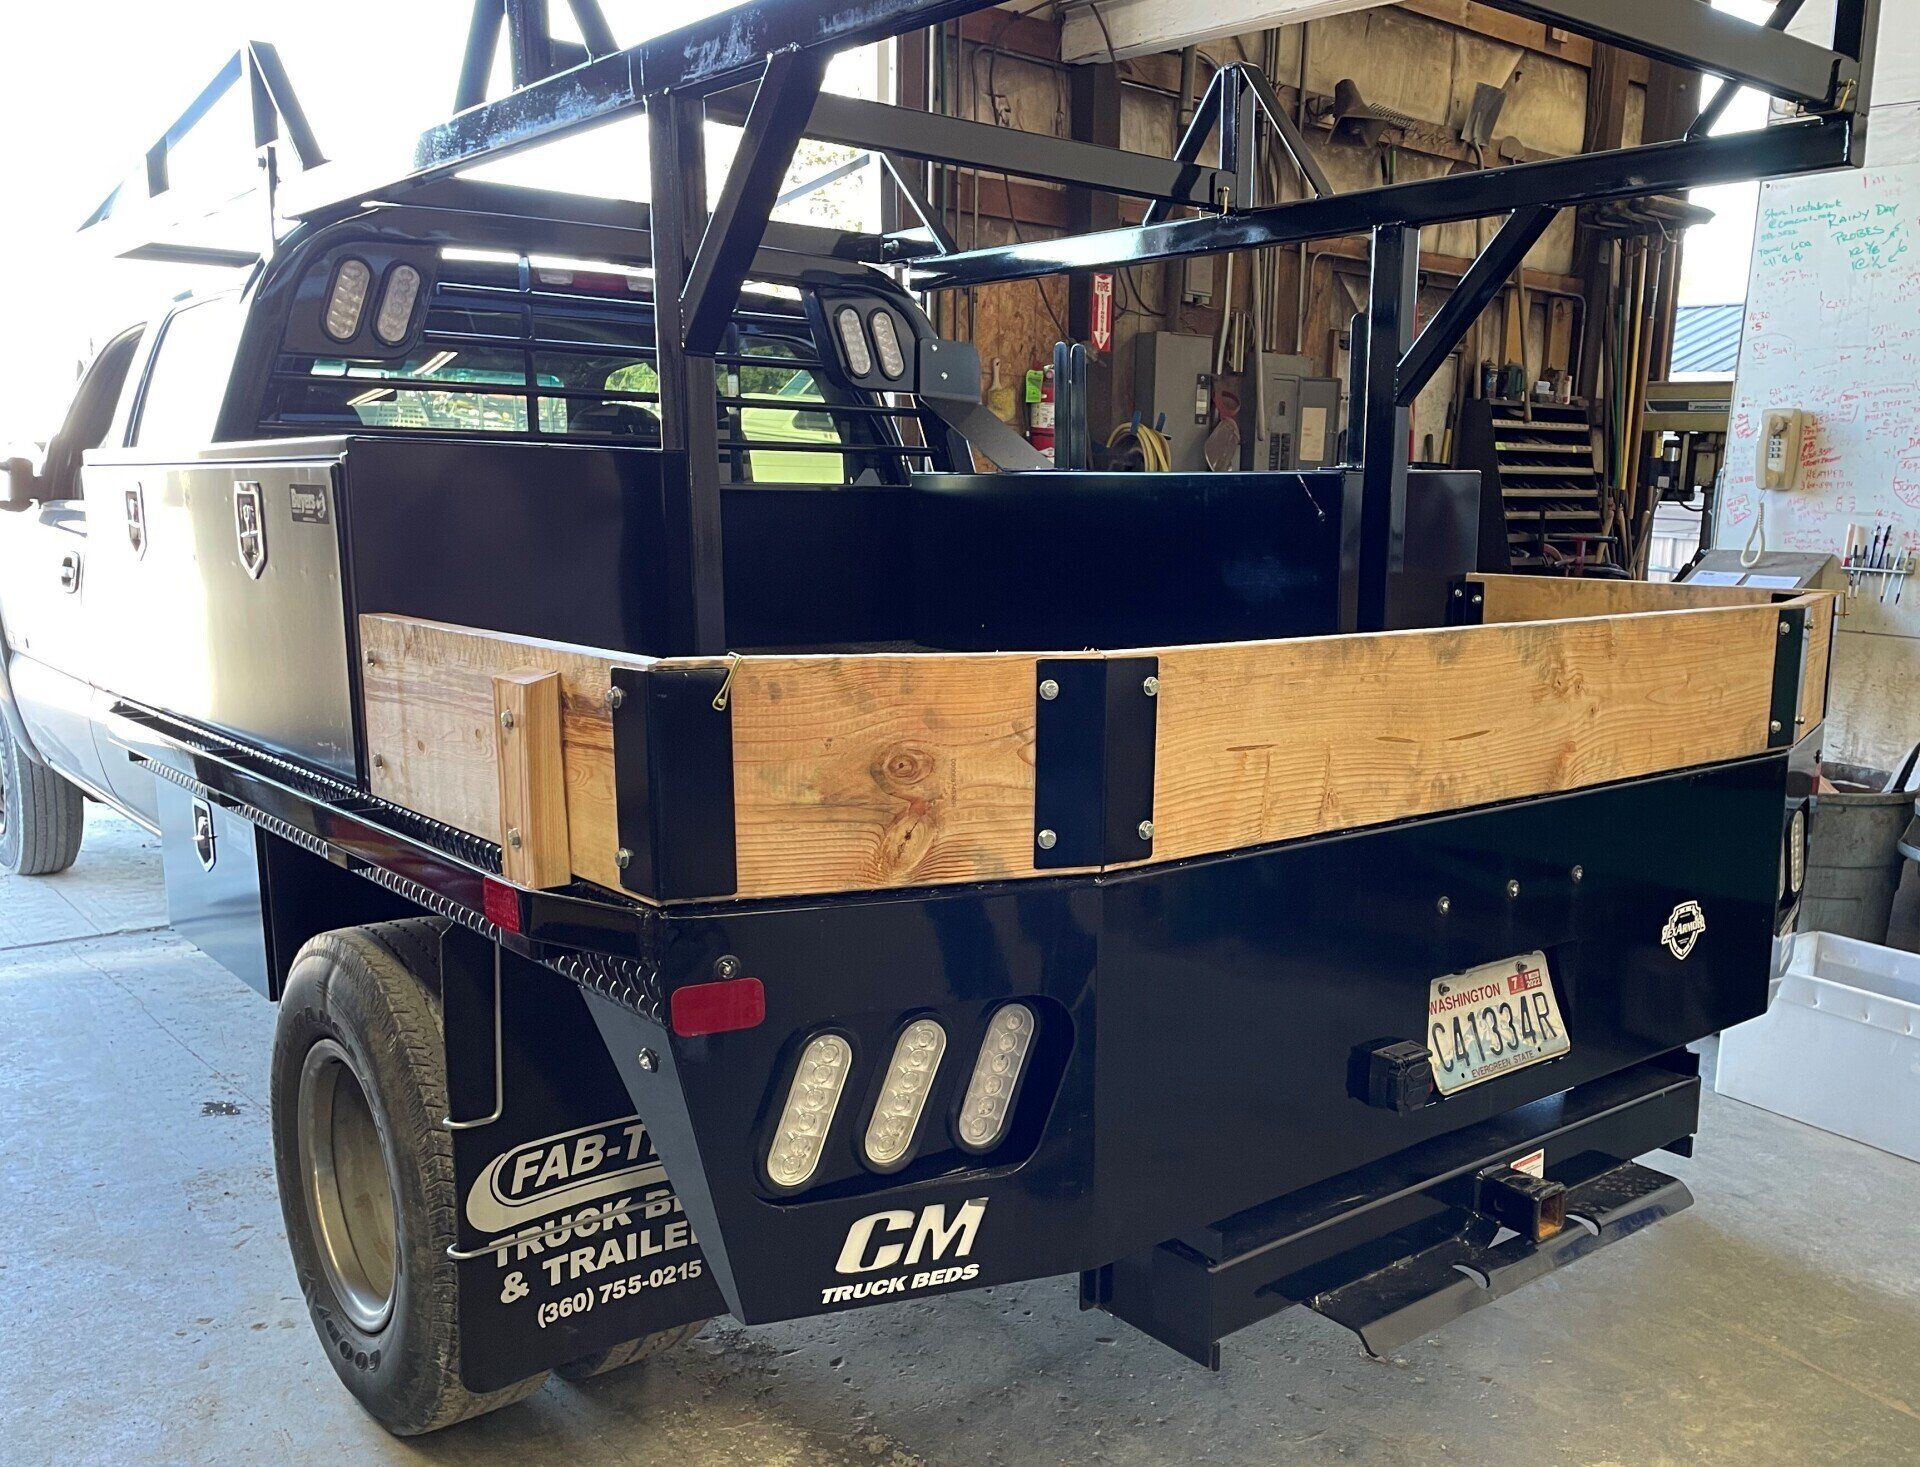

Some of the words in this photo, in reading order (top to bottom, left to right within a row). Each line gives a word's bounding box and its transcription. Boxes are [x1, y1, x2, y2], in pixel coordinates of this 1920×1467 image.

[1429, 982, 1501, 1016] WASHINGTON
[1510, 976, 1518, 990] 7
[1432, 991, 1558, 1073] C41334R
[1471, 1060, 1512, 1078] EVERGREEN
[1512, 1050, 1535, 1066] STATE
[510, 1123, 658, 1195] FAB-T
[489, 1197, 632, 1268] TRUCK
[835, 1196, 990, 1274] CM
[501, 1271, 530, 1304] &
[537, 1287, 595, 1329] (360)
[599, 1259, 702, 1304] 755-0215
[821, 1275, 909, 1305] TRUCK
[910, 1263, 980, 1290] BEDS
